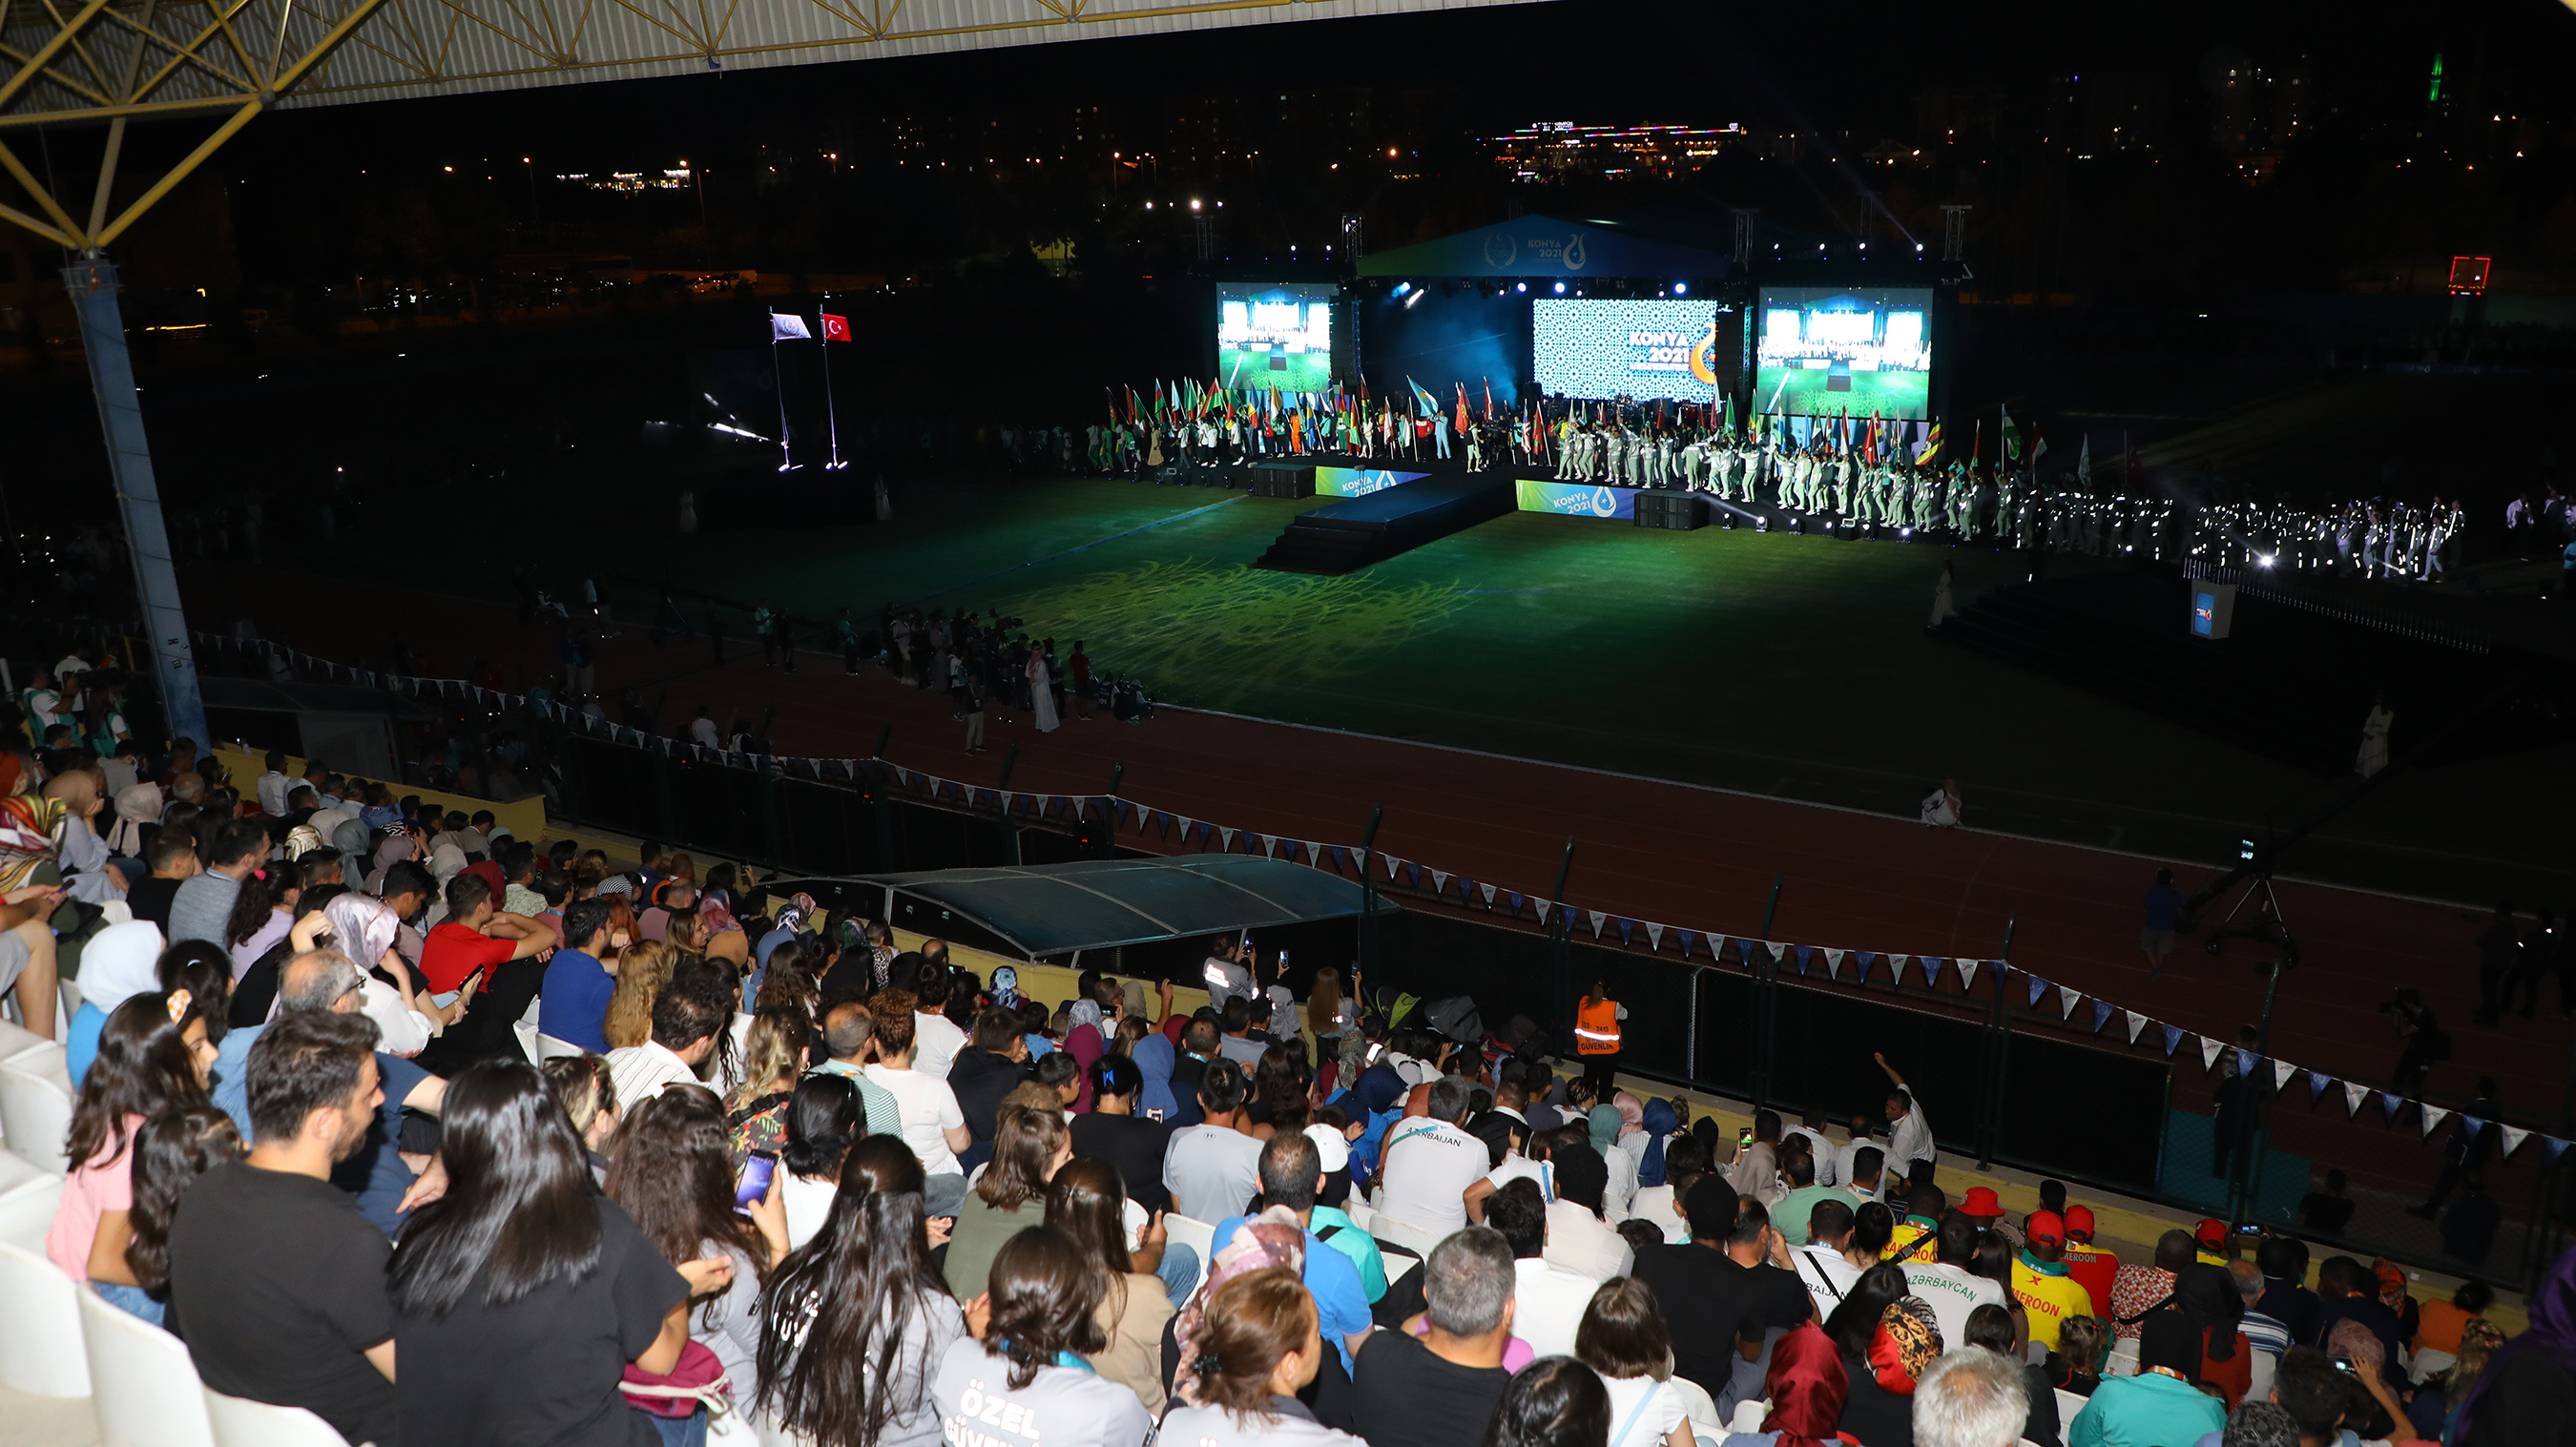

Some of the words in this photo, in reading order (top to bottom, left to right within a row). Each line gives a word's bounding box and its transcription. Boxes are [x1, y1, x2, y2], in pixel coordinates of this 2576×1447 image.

[1527, 239, 1562, 248] KONYA
[1539, 249, 1562, 258] 2021
[1630, 330, 1689, 346] KONYA
[1648, 346, 1690, 362] 2021
[1341, 476, 1374, 492] KONYA
[1354, 484, 1376, 498] 2021
[1553, 491, 1589, 508] KONYA
[1567, 501, 1591, 515] 2021
[1406, 1127, 1461, 1147] ARBAIJAN
[2061, 1252, 2097, 1263] MEROON
[960, 1377, 1041, 1440] ÖZEL
